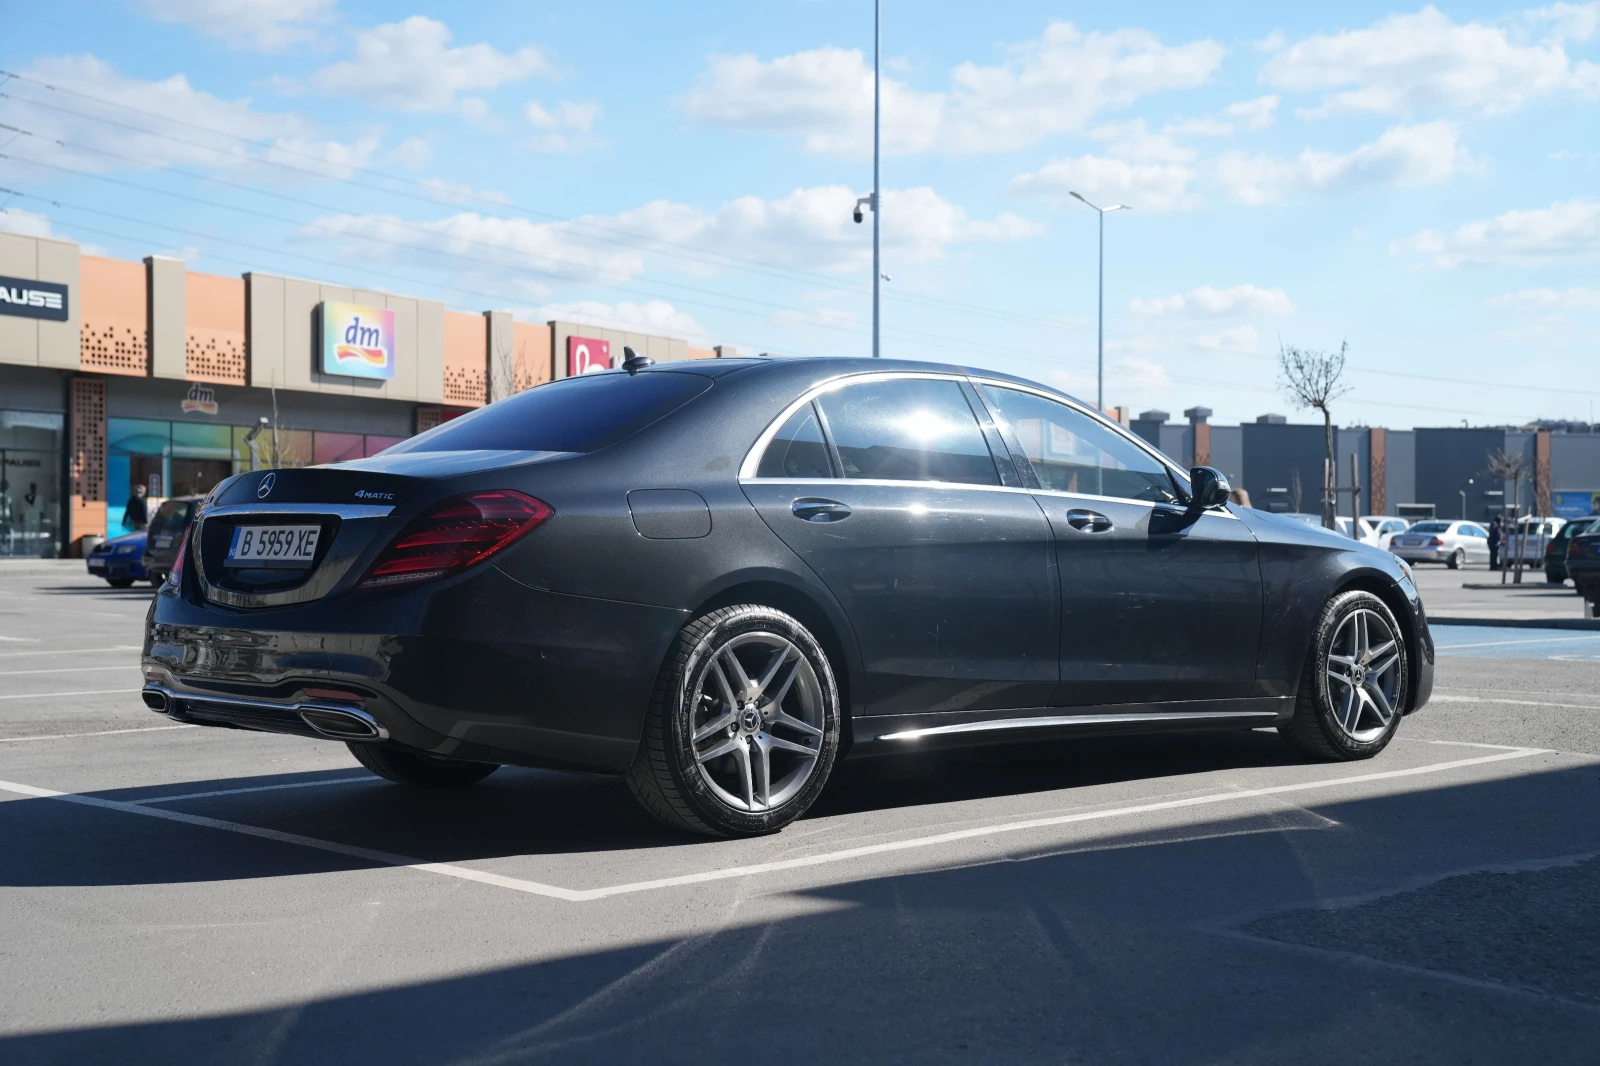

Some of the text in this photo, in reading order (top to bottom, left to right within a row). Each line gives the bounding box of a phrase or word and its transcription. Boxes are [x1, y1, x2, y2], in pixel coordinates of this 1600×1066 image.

[345, 316, 380, 347] dm
[189, 384, 213, 402] dm
[354, 489, 395, 500] 4MATIC
[240, 530, 318, 556] B 5959 XE
